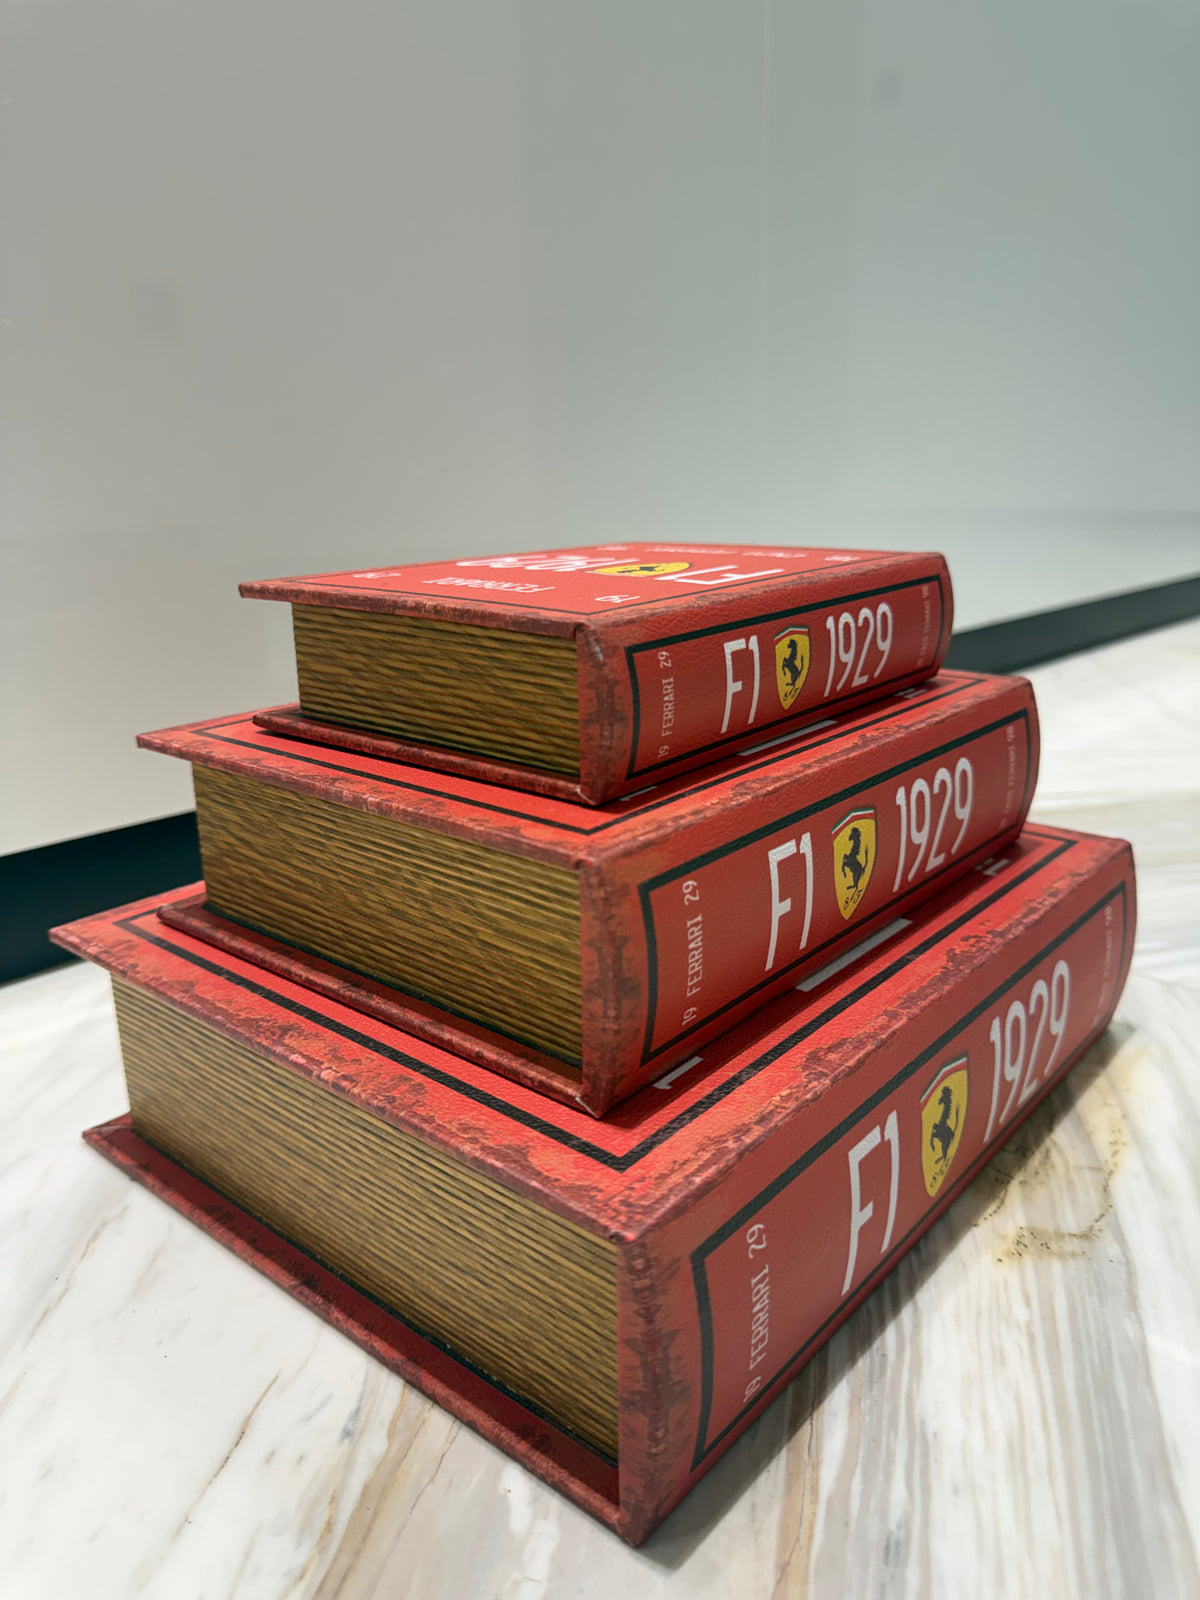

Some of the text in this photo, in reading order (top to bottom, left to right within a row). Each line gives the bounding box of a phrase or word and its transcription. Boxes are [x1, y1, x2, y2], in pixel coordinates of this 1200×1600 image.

[657, 650, 675, 759] 19 FERRARI 29
[721, 602, 893, 734] F1 1929
[765, 831, 814, 971] F1
[893, 757, 974, 892] 1929
[681, 880, 703, 1026] 19 FERRARI 29
[841, 959, 1071, 1296] F1 1929
[742, 1222, 771, 1404] 19 FERRARI 29
